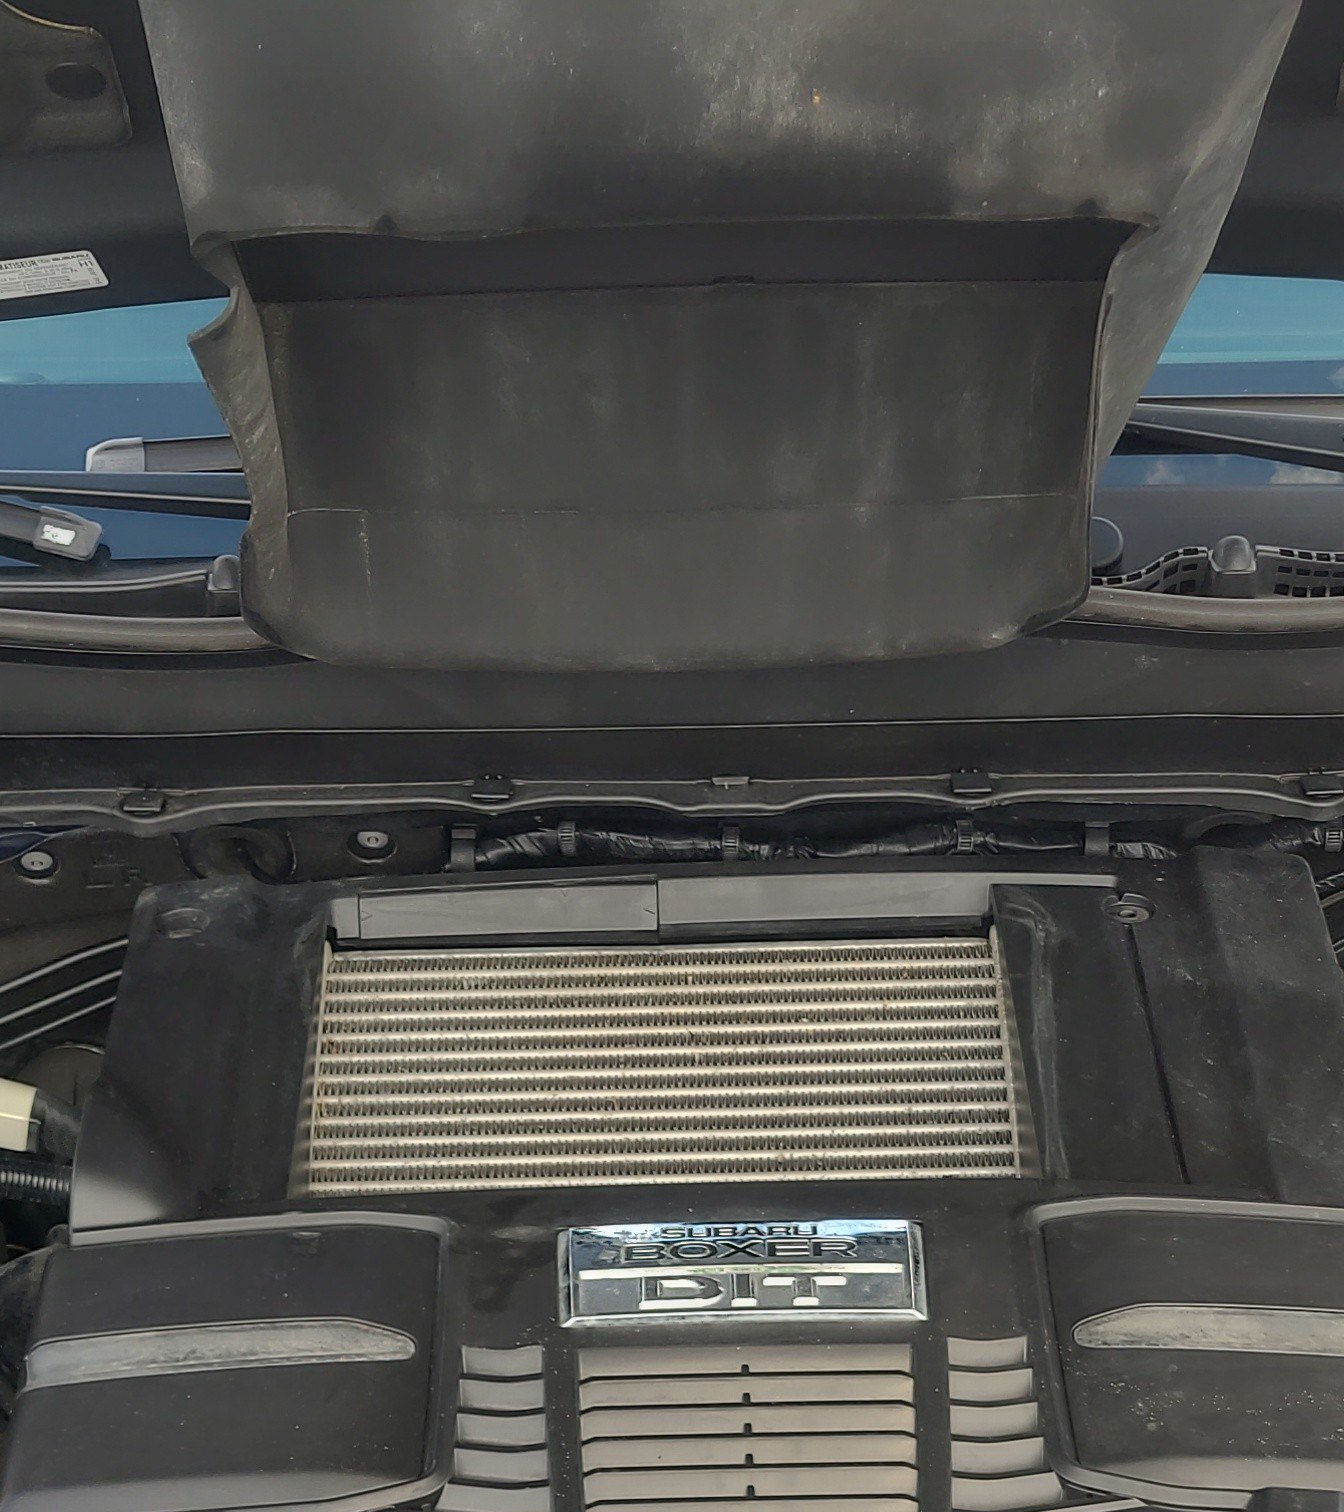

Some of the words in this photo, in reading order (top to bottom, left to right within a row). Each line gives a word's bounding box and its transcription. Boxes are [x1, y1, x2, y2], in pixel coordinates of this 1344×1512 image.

[660, 1225, 818, 1239] SUBARU
[623, 1237, 857, 1262] BOXER
[639, 1273, 848, 1308] DIT
